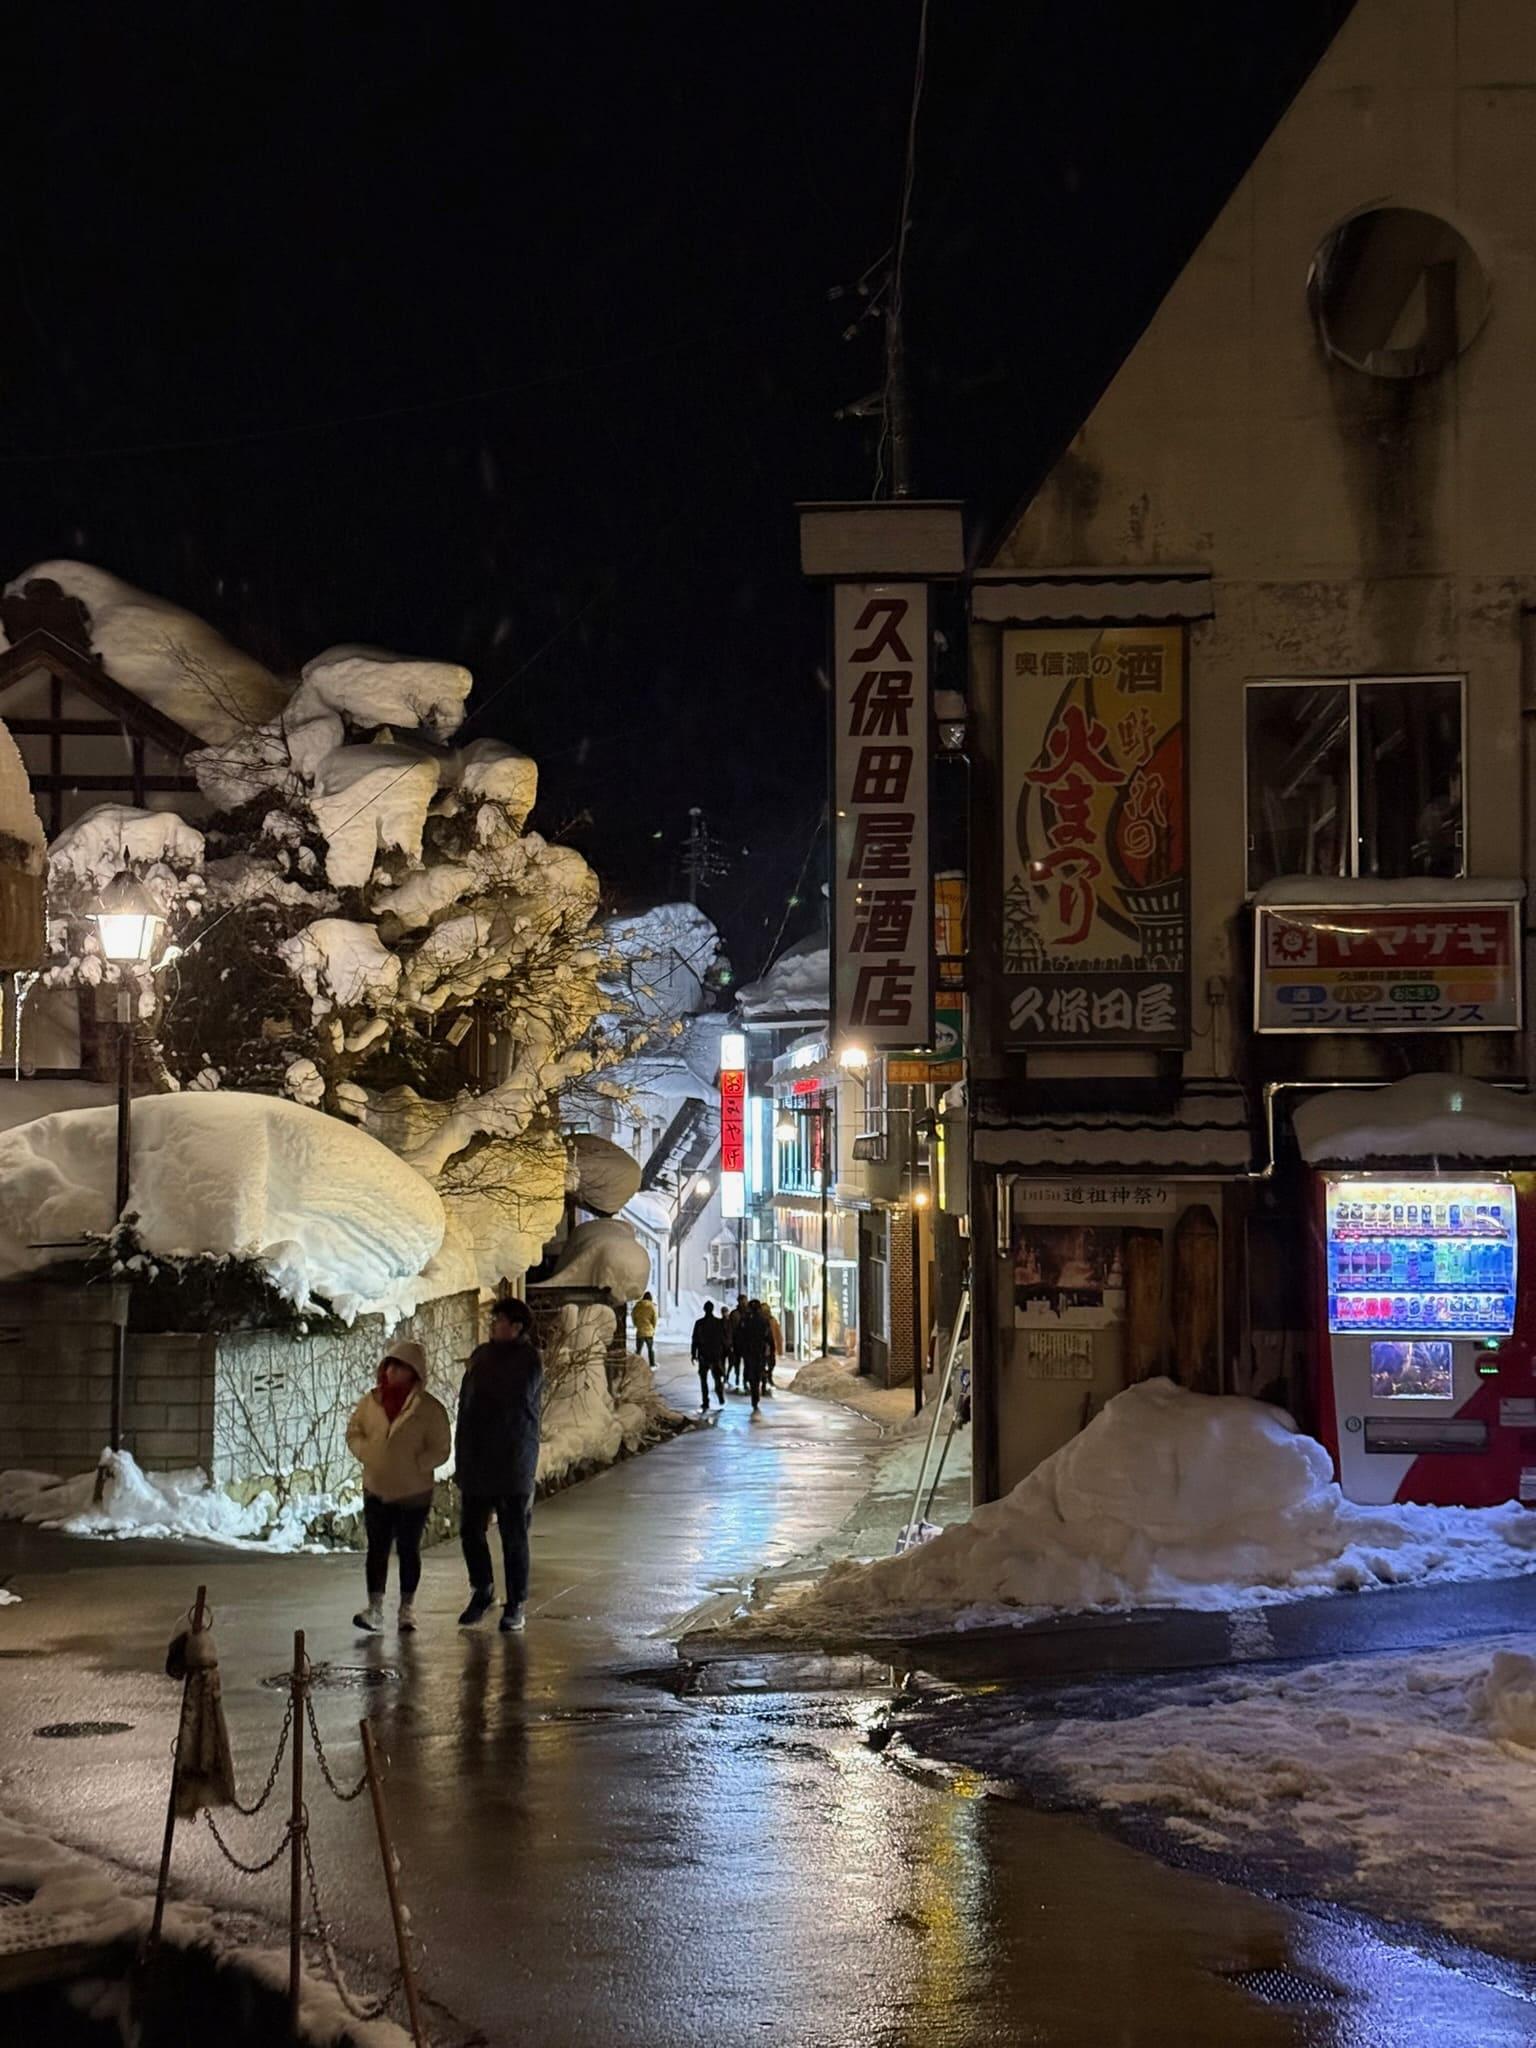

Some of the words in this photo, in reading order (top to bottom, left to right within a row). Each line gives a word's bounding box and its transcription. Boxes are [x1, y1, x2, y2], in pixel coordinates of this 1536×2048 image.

[1014, 643, 1166, 695] 奥信濃の酒
[848, 599, 916, 1027] 久保田屋酒店
[1023, 703, 1128, 946] 火まつり
[1333, 923, 1498, 956] ヤマザキ
[1009, 983, 1178, 1034] 久保田屋
[1291, 1004, 1484, 1023] コンビニエンス
[1063, 1185, 1167, 1205] 道祖神祭り
